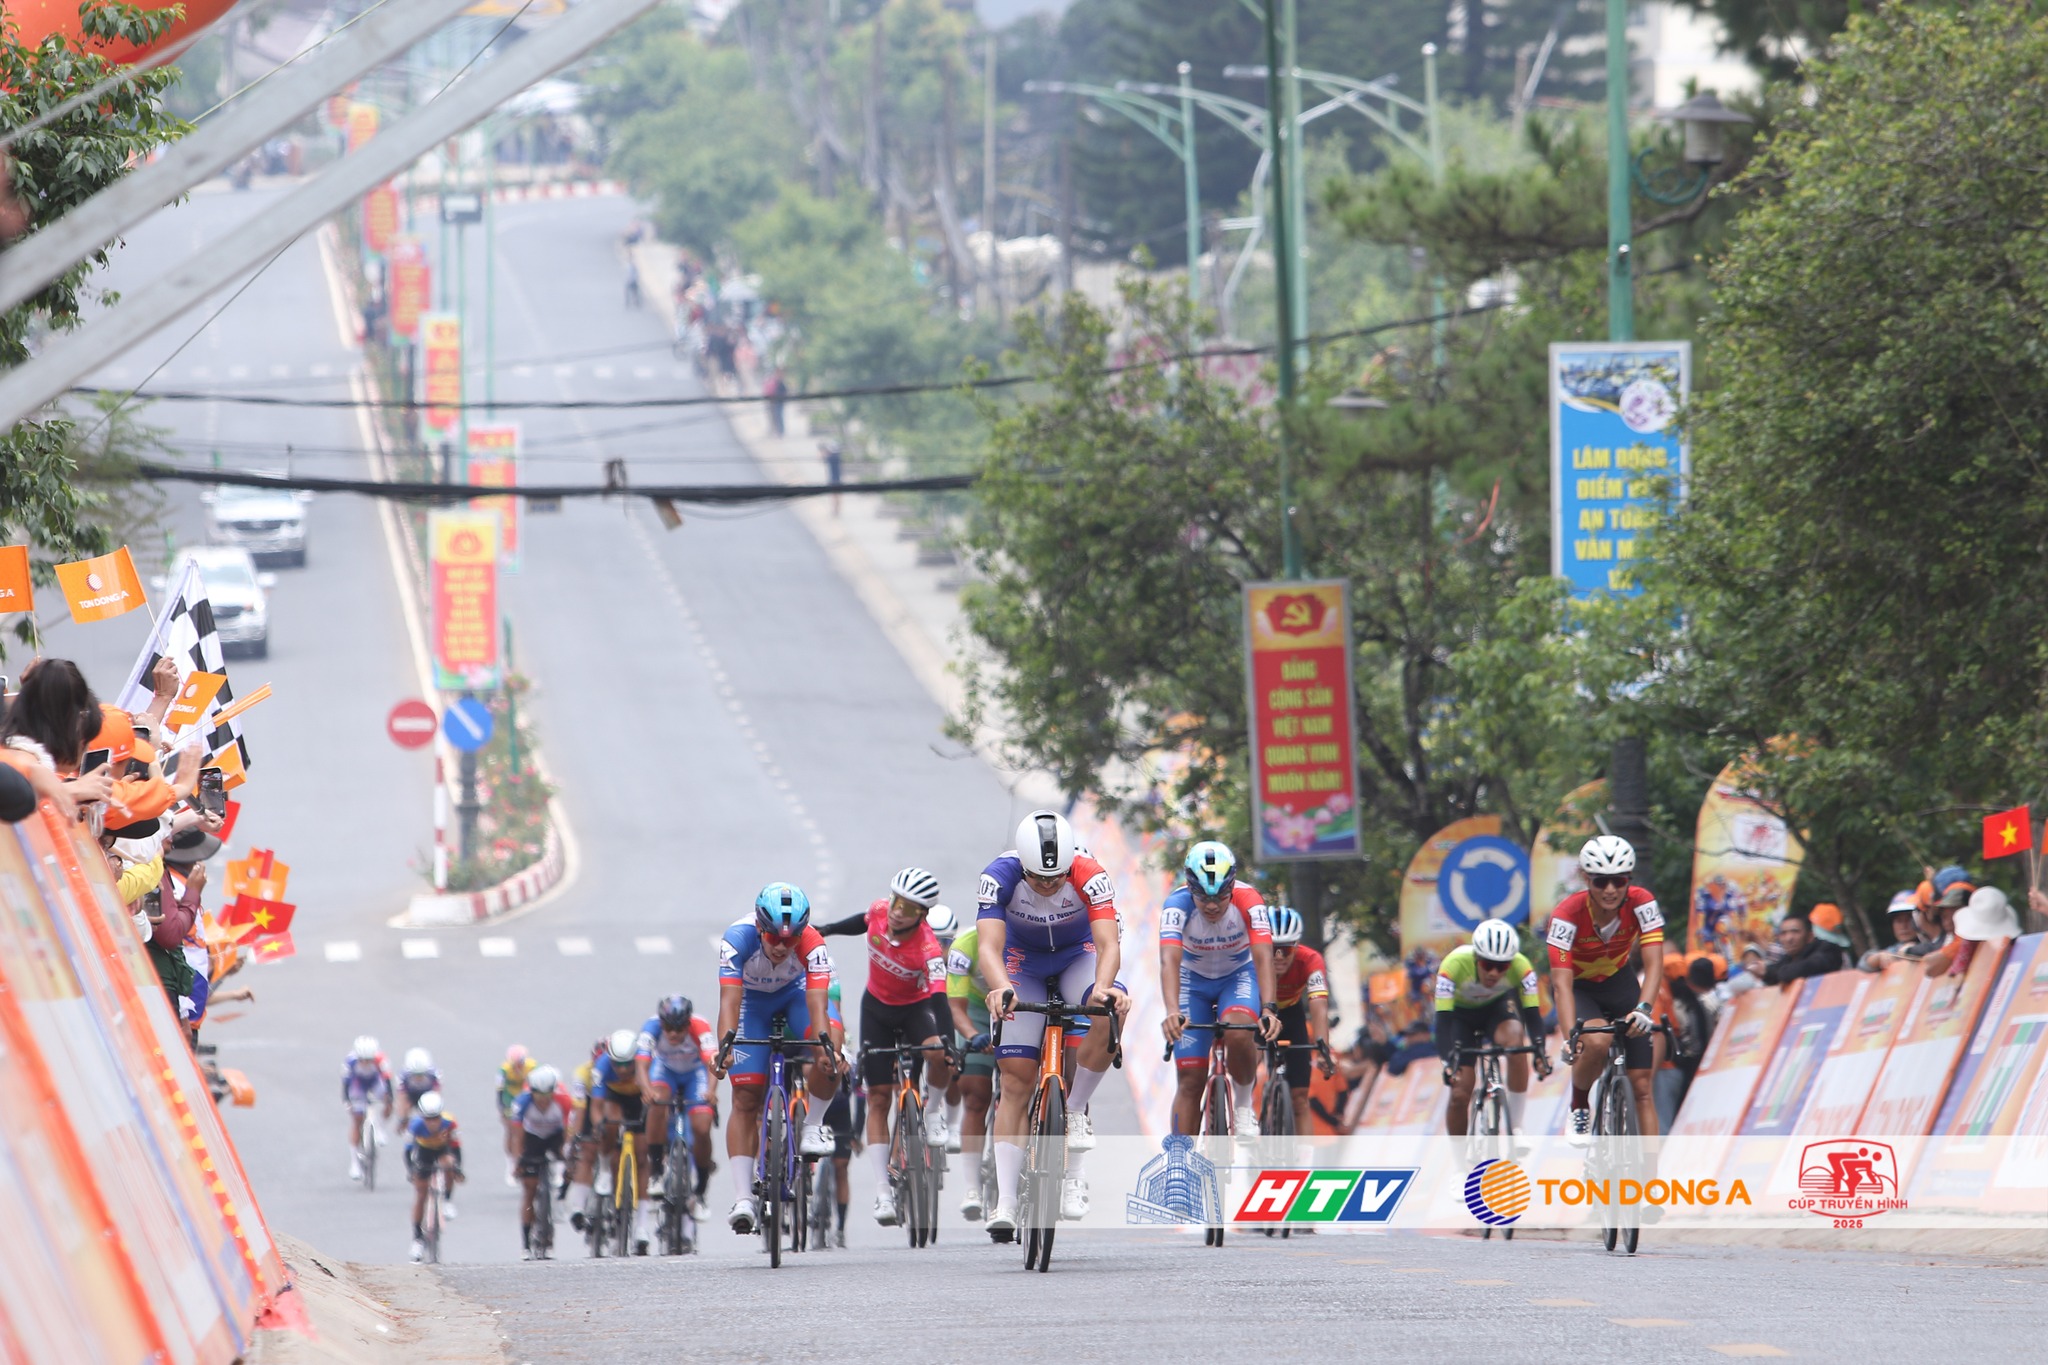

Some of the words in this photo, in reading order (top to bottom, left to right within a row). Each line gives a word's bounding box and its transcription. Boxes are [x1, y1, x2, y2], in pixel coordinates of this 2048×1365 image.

[78, 600, 95, 610] TON
[95, 593, 120, 607] DONG
[1088, 876, 1111, 897] 107
[1164, 911, 1181, 926] 13
[1550, 923, 1574, 943] 124
[814, 948, 828, 965] 14
[868, 948, 914, 978] ENDA
